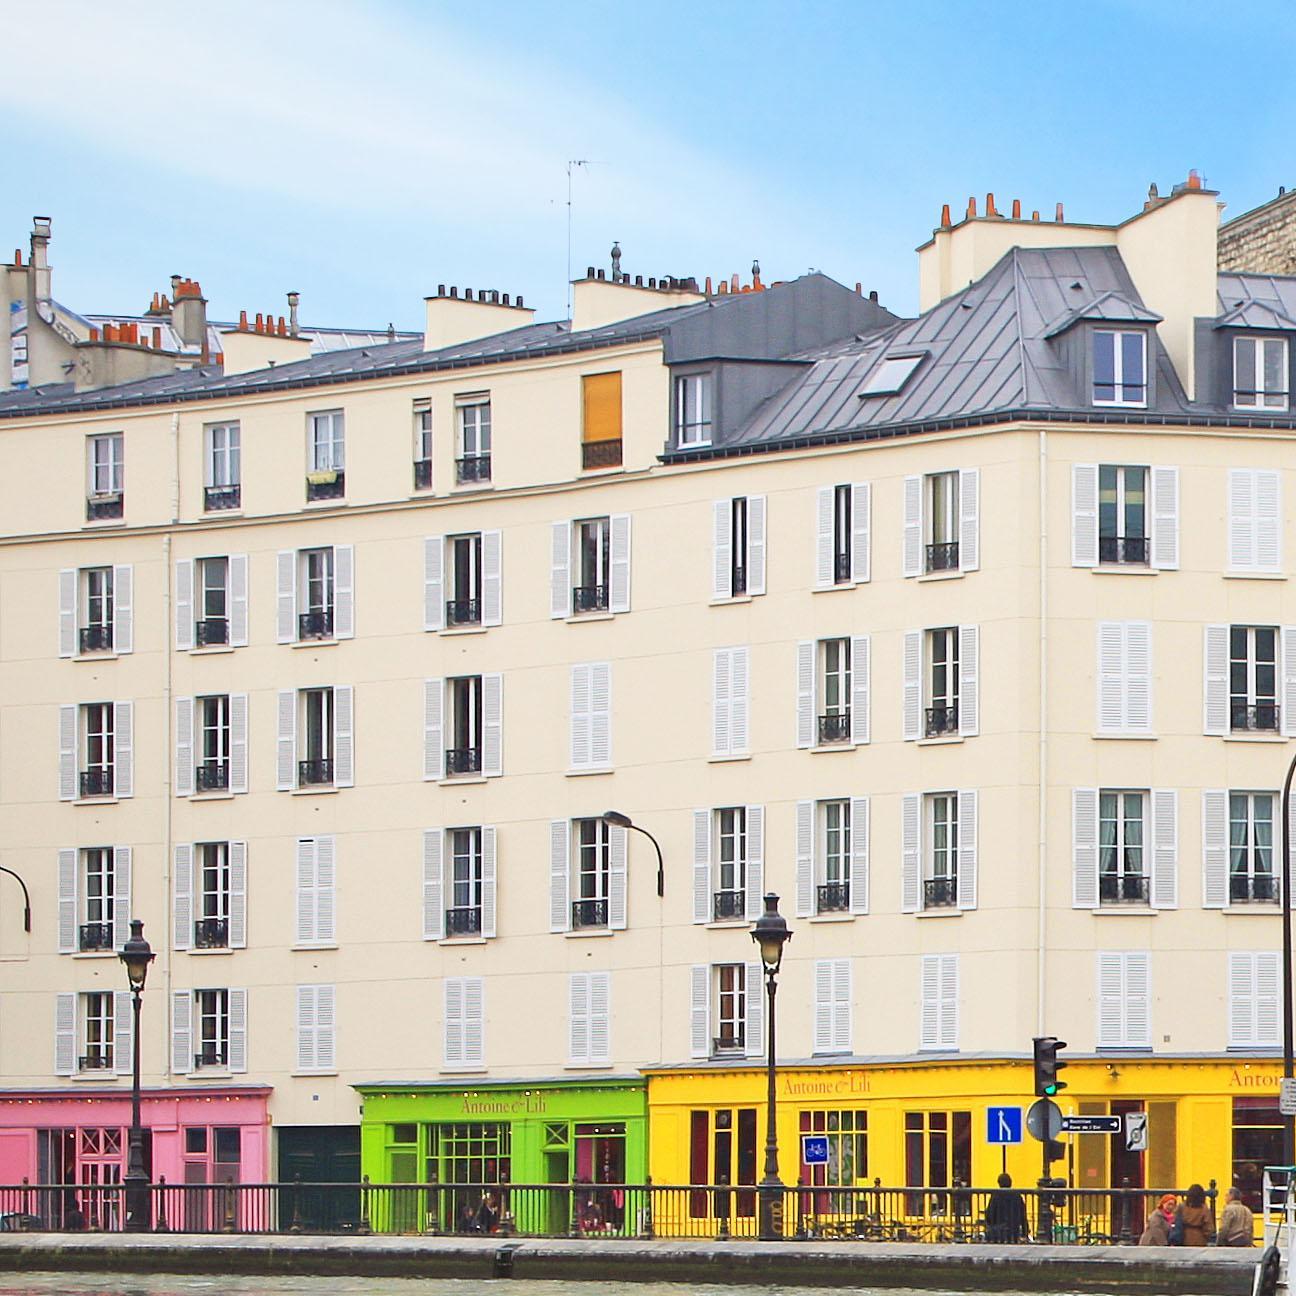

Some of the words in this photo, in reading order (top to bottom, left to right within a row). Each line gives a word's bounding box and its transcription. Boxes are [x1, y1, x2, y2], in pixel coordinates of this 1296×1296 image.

[782, 1078, 834, 1095] Antoine
[850, 1072, 871, 1093] Lili
[1228, 1069, 1281, 1087] Antoi
[461, 1098, 510, 1114] Antoine
[526, 1096, 546, 1113] Lili
